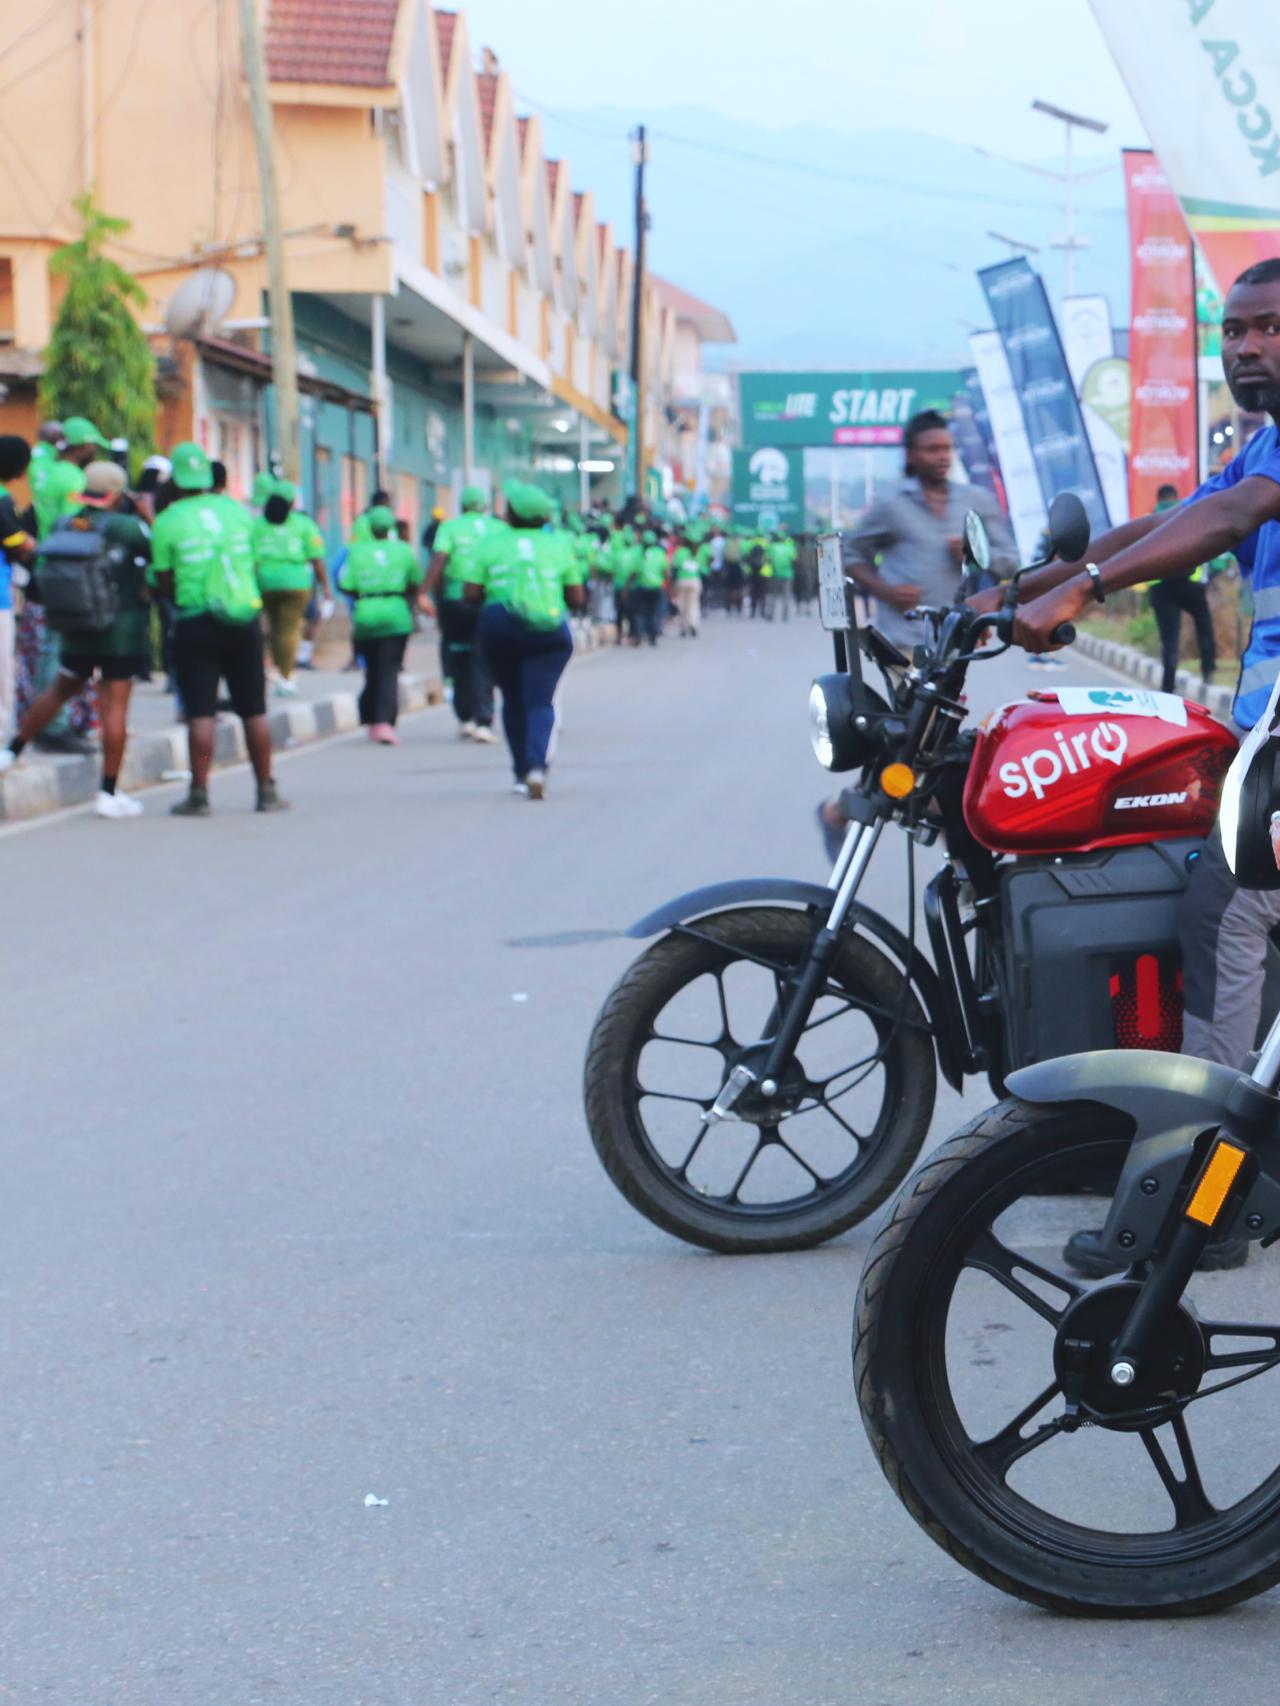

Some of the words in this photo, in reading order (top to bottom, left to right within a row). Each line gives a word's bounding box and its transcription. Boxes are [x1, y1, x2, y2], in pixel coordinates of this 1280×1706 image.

[829, 388, 916, 423] START
[999, 722, 1128, 800] spiro
[1114, 791, 1187, 810] EKON
